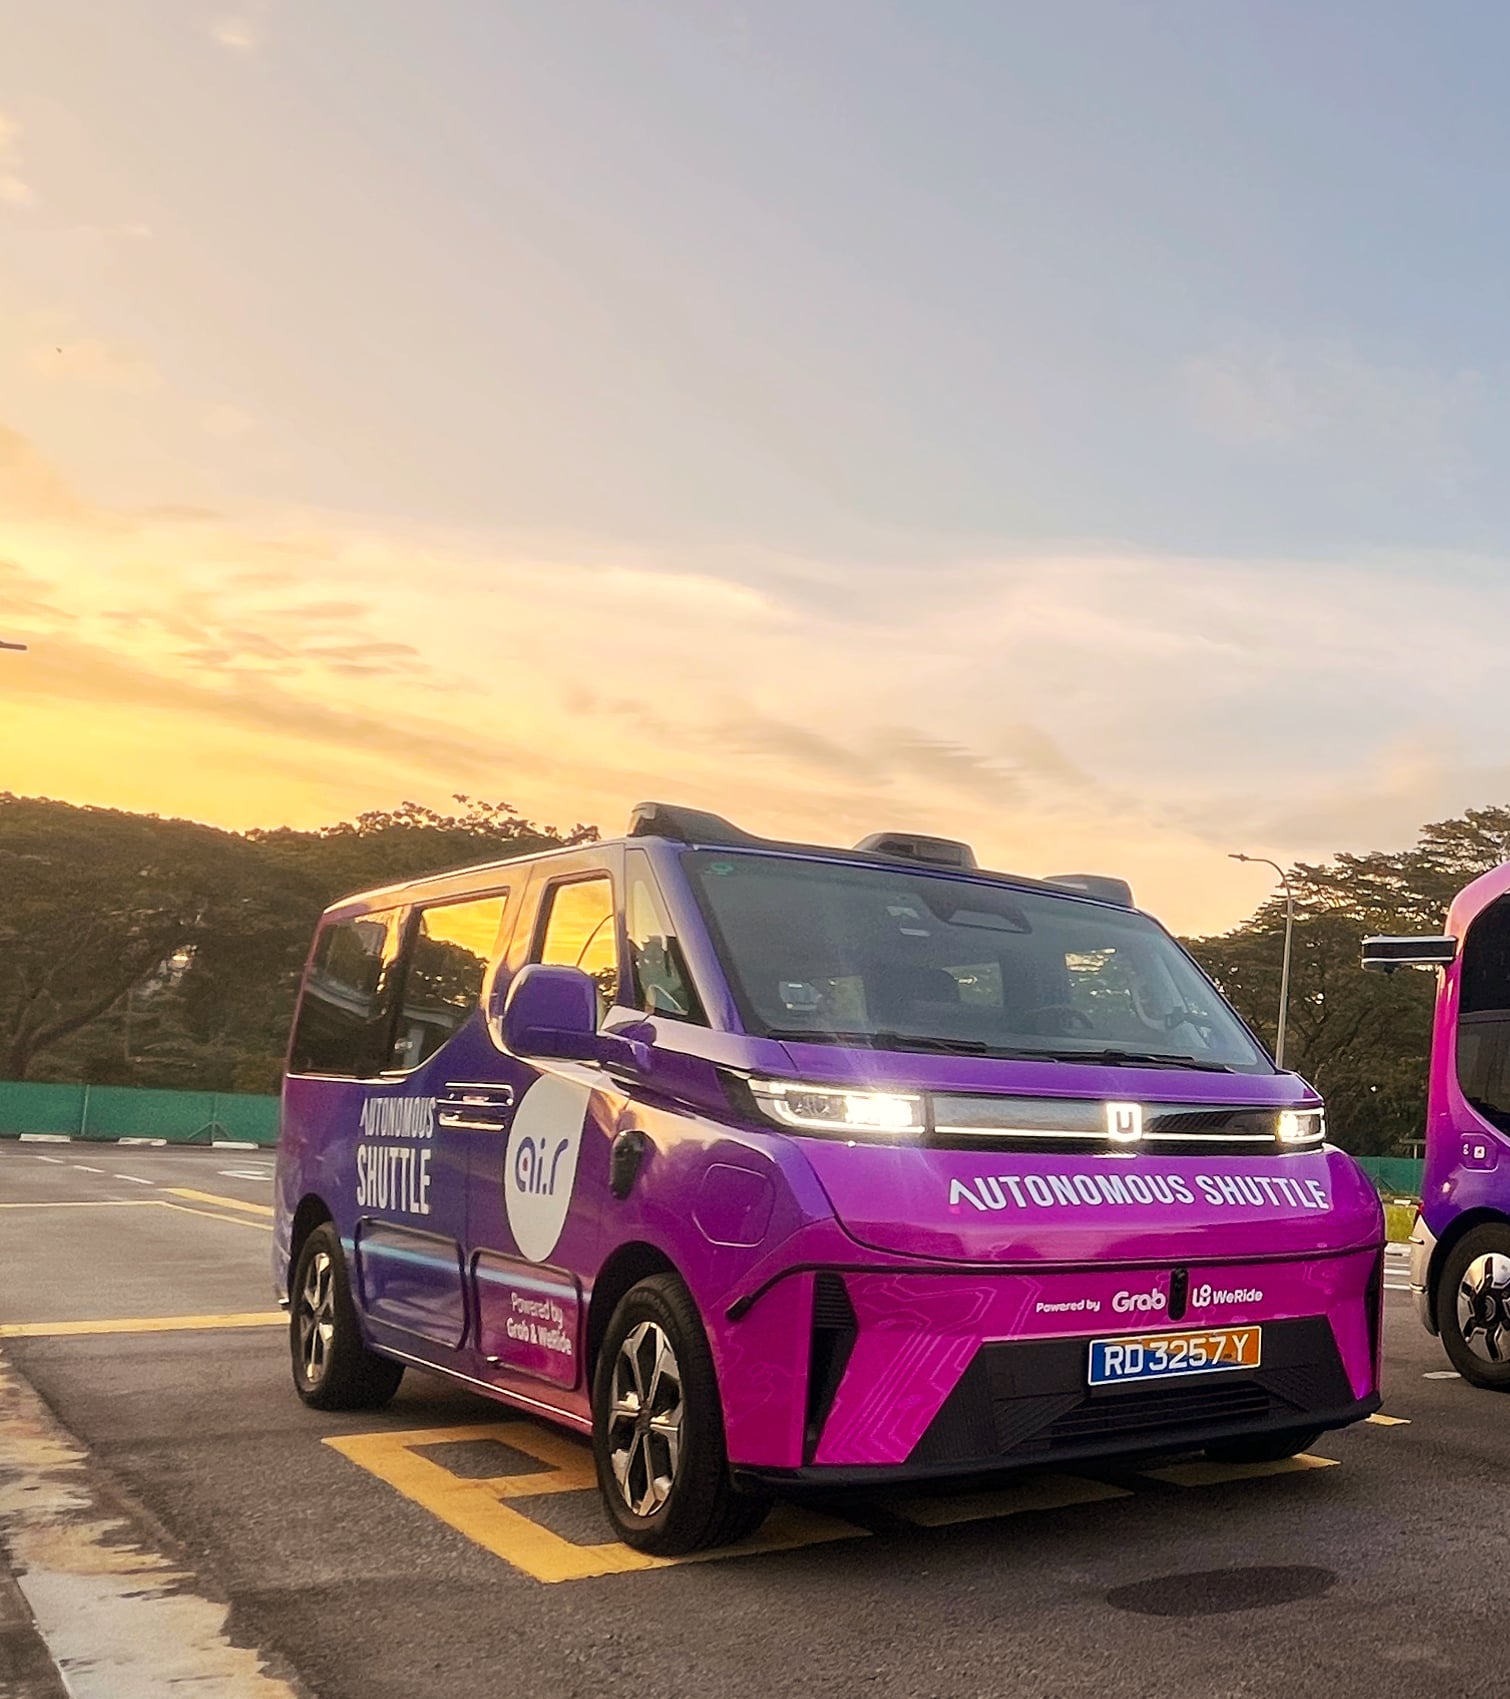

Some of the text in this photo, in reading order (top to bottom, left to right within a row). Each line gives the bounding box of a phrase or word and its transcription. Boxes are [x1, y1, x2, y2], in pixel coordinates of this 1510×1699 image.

[359, 1096, 436, 1138] AUTONOMOUS
[356, 1144, 431, 1214] SHUTTLE
[949, 1174, 1330, 1211] AUTONOMOUS SHUTTLE
[511, 1291, 563, 1329] Powered by
[1036, 1288, 1263, 1313] Powered by Grab WeRide
[1104, 1333, 1249, 1377] RD 3257 Y
